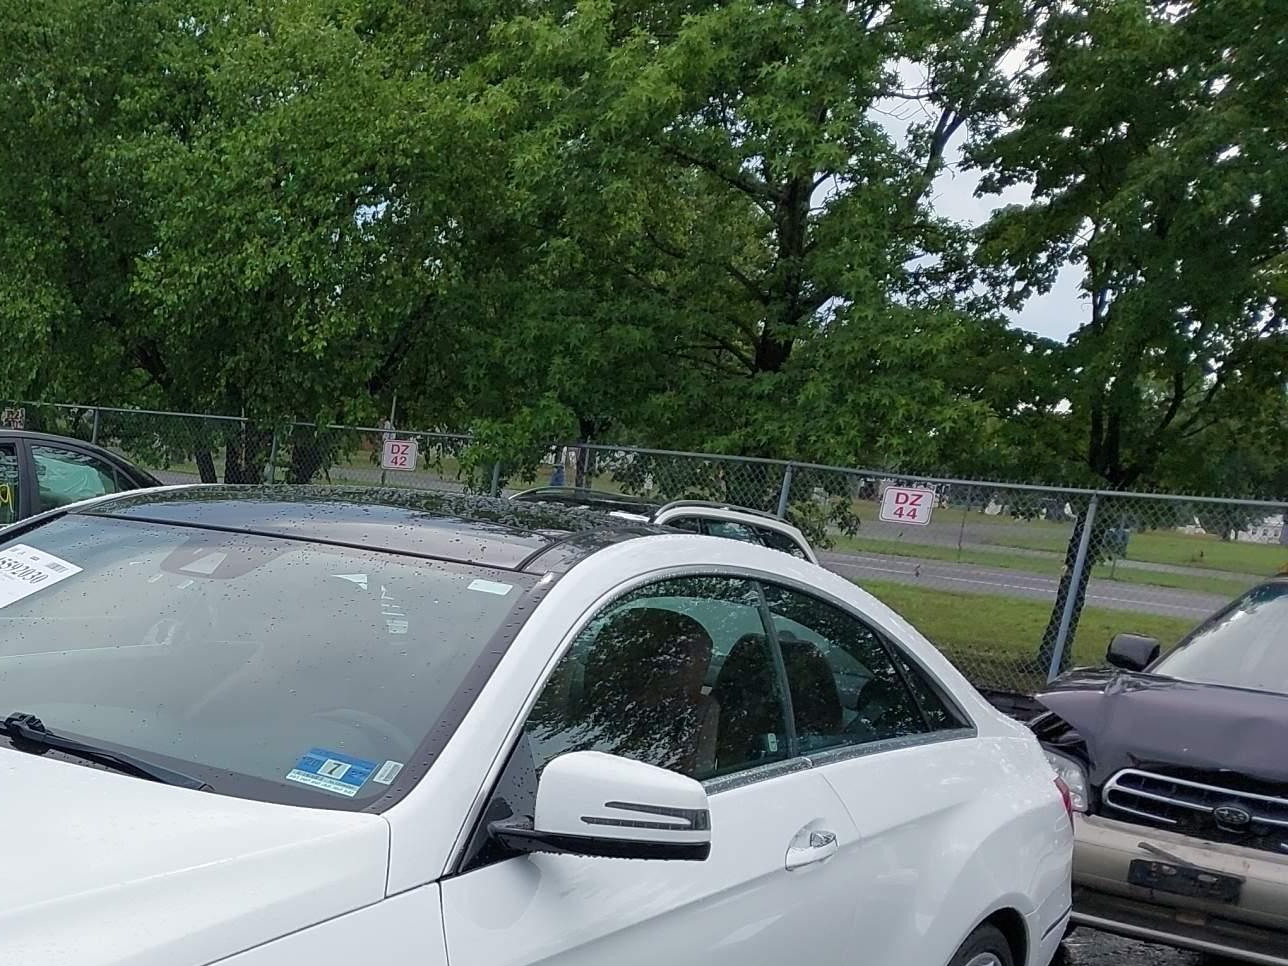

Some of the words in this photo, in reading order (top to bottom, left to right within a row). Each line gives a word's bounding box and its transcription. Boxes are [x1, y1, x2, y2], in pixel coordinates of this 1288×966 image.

[391, 444, 409, 455] DZ
[391, 456, 407, 466] 42
[895, 492, 923, 506] DZ
[893, 507, 917, 519] 44
[328, 762, 342, 775] 7
